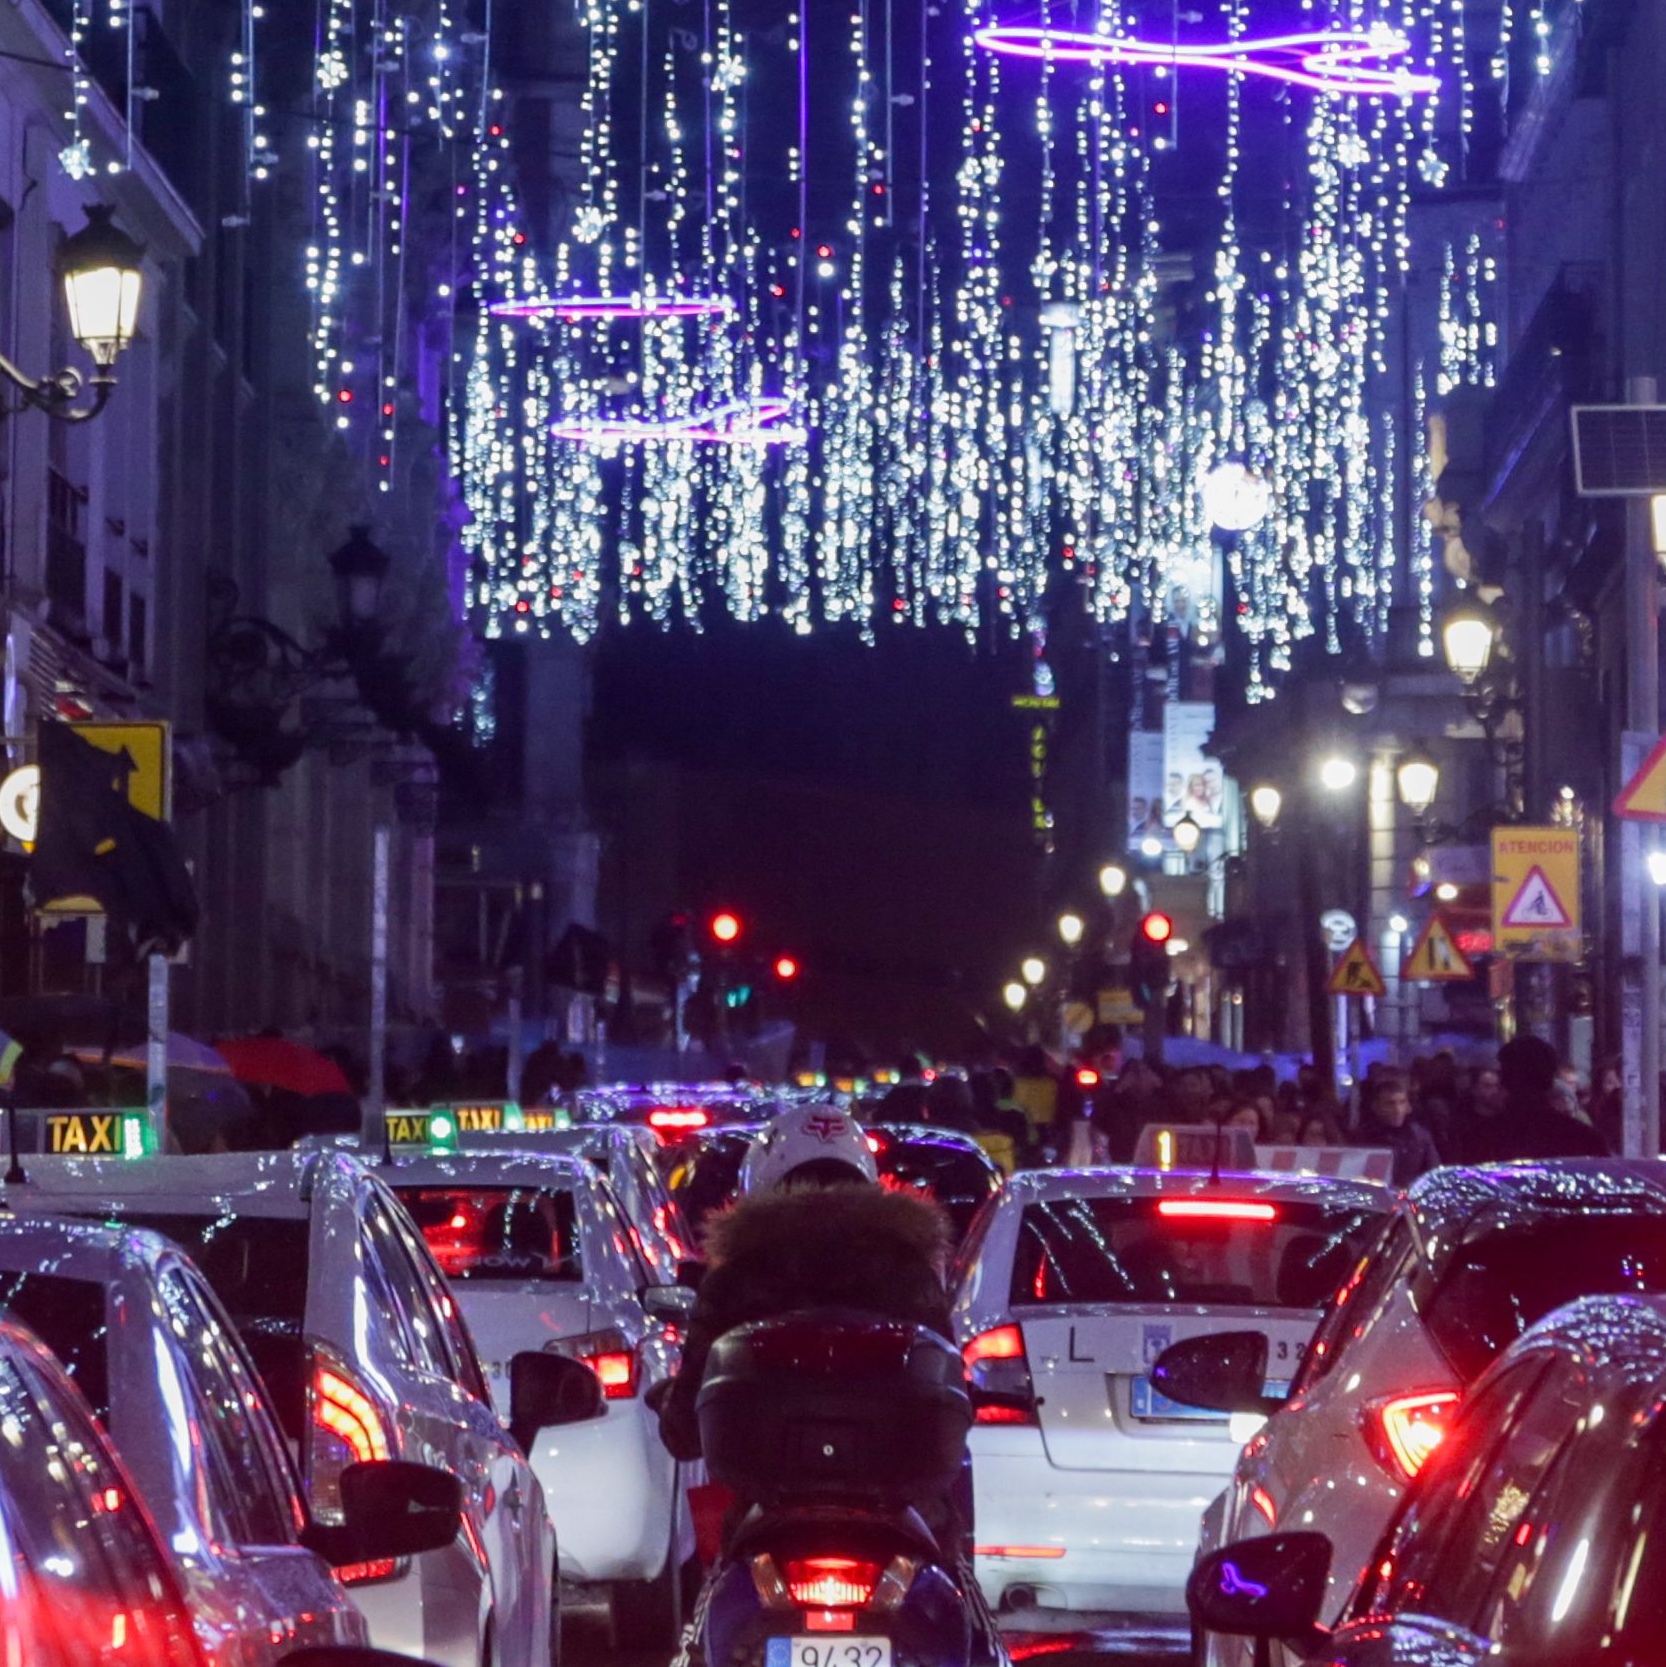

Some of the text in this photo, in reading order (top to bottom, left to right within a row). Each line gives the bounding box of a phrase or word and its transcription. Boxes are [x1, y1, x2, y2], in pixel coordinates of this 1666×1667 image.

[1499, 840, 1574, 853] ATENCION
[386, 1117, 429, 1142] TAXI
[458, 1107, 501, 1131] TAXI
[48, 1115, 122, 1153] TAXI
